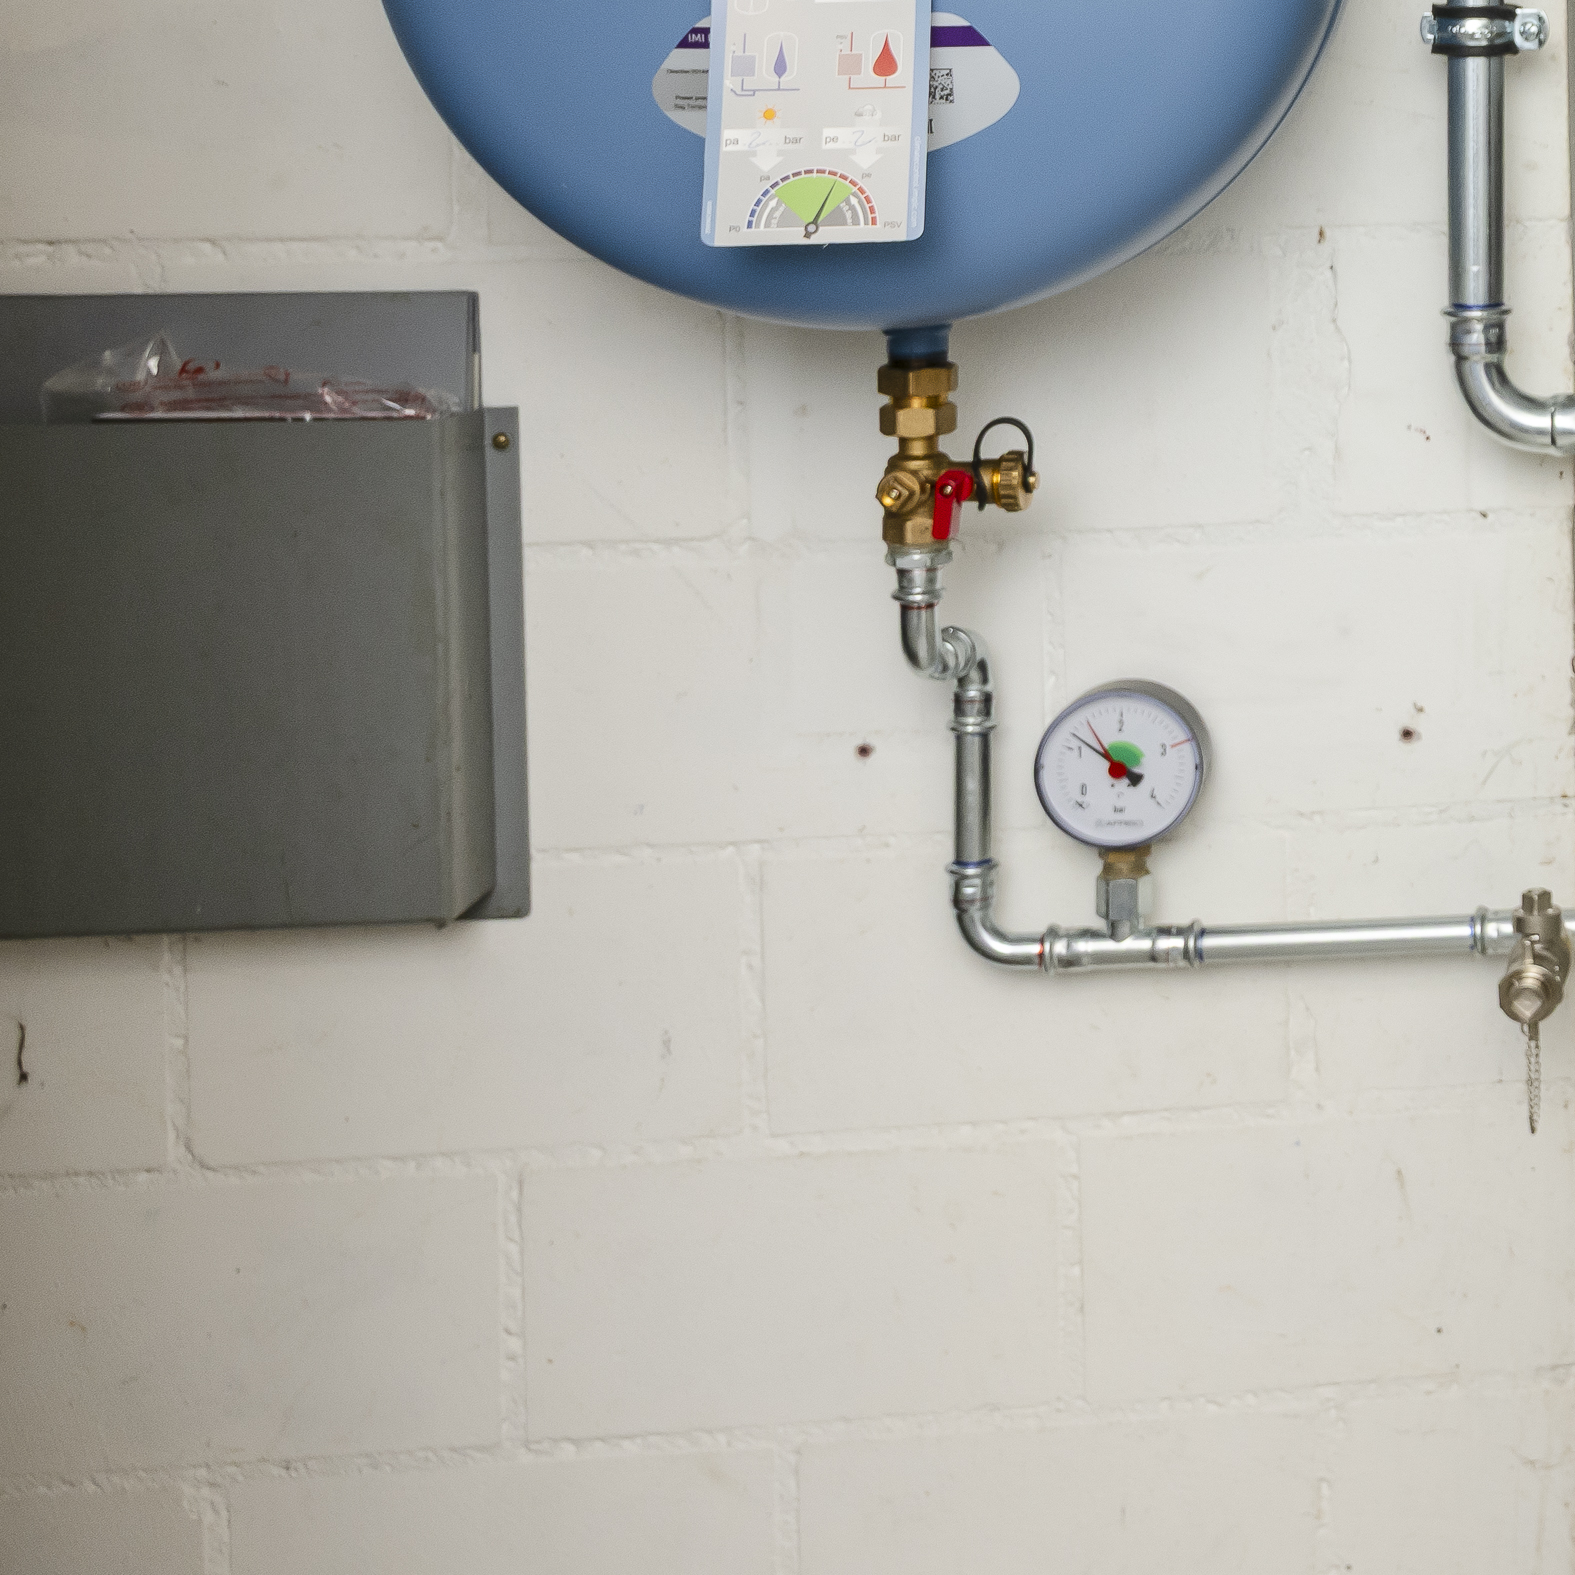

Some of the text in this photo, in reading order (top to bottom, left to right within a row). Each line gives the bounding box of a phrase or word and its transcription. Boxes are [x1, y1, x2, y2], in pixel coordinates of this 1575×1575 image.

[688, 33, 705, 43] IMI
[724, 136, 740, 148] pa
[784, 136, 804, 145] bar
[824, 134, 839, 145] pe
[882, 132, 902, 142] bar
